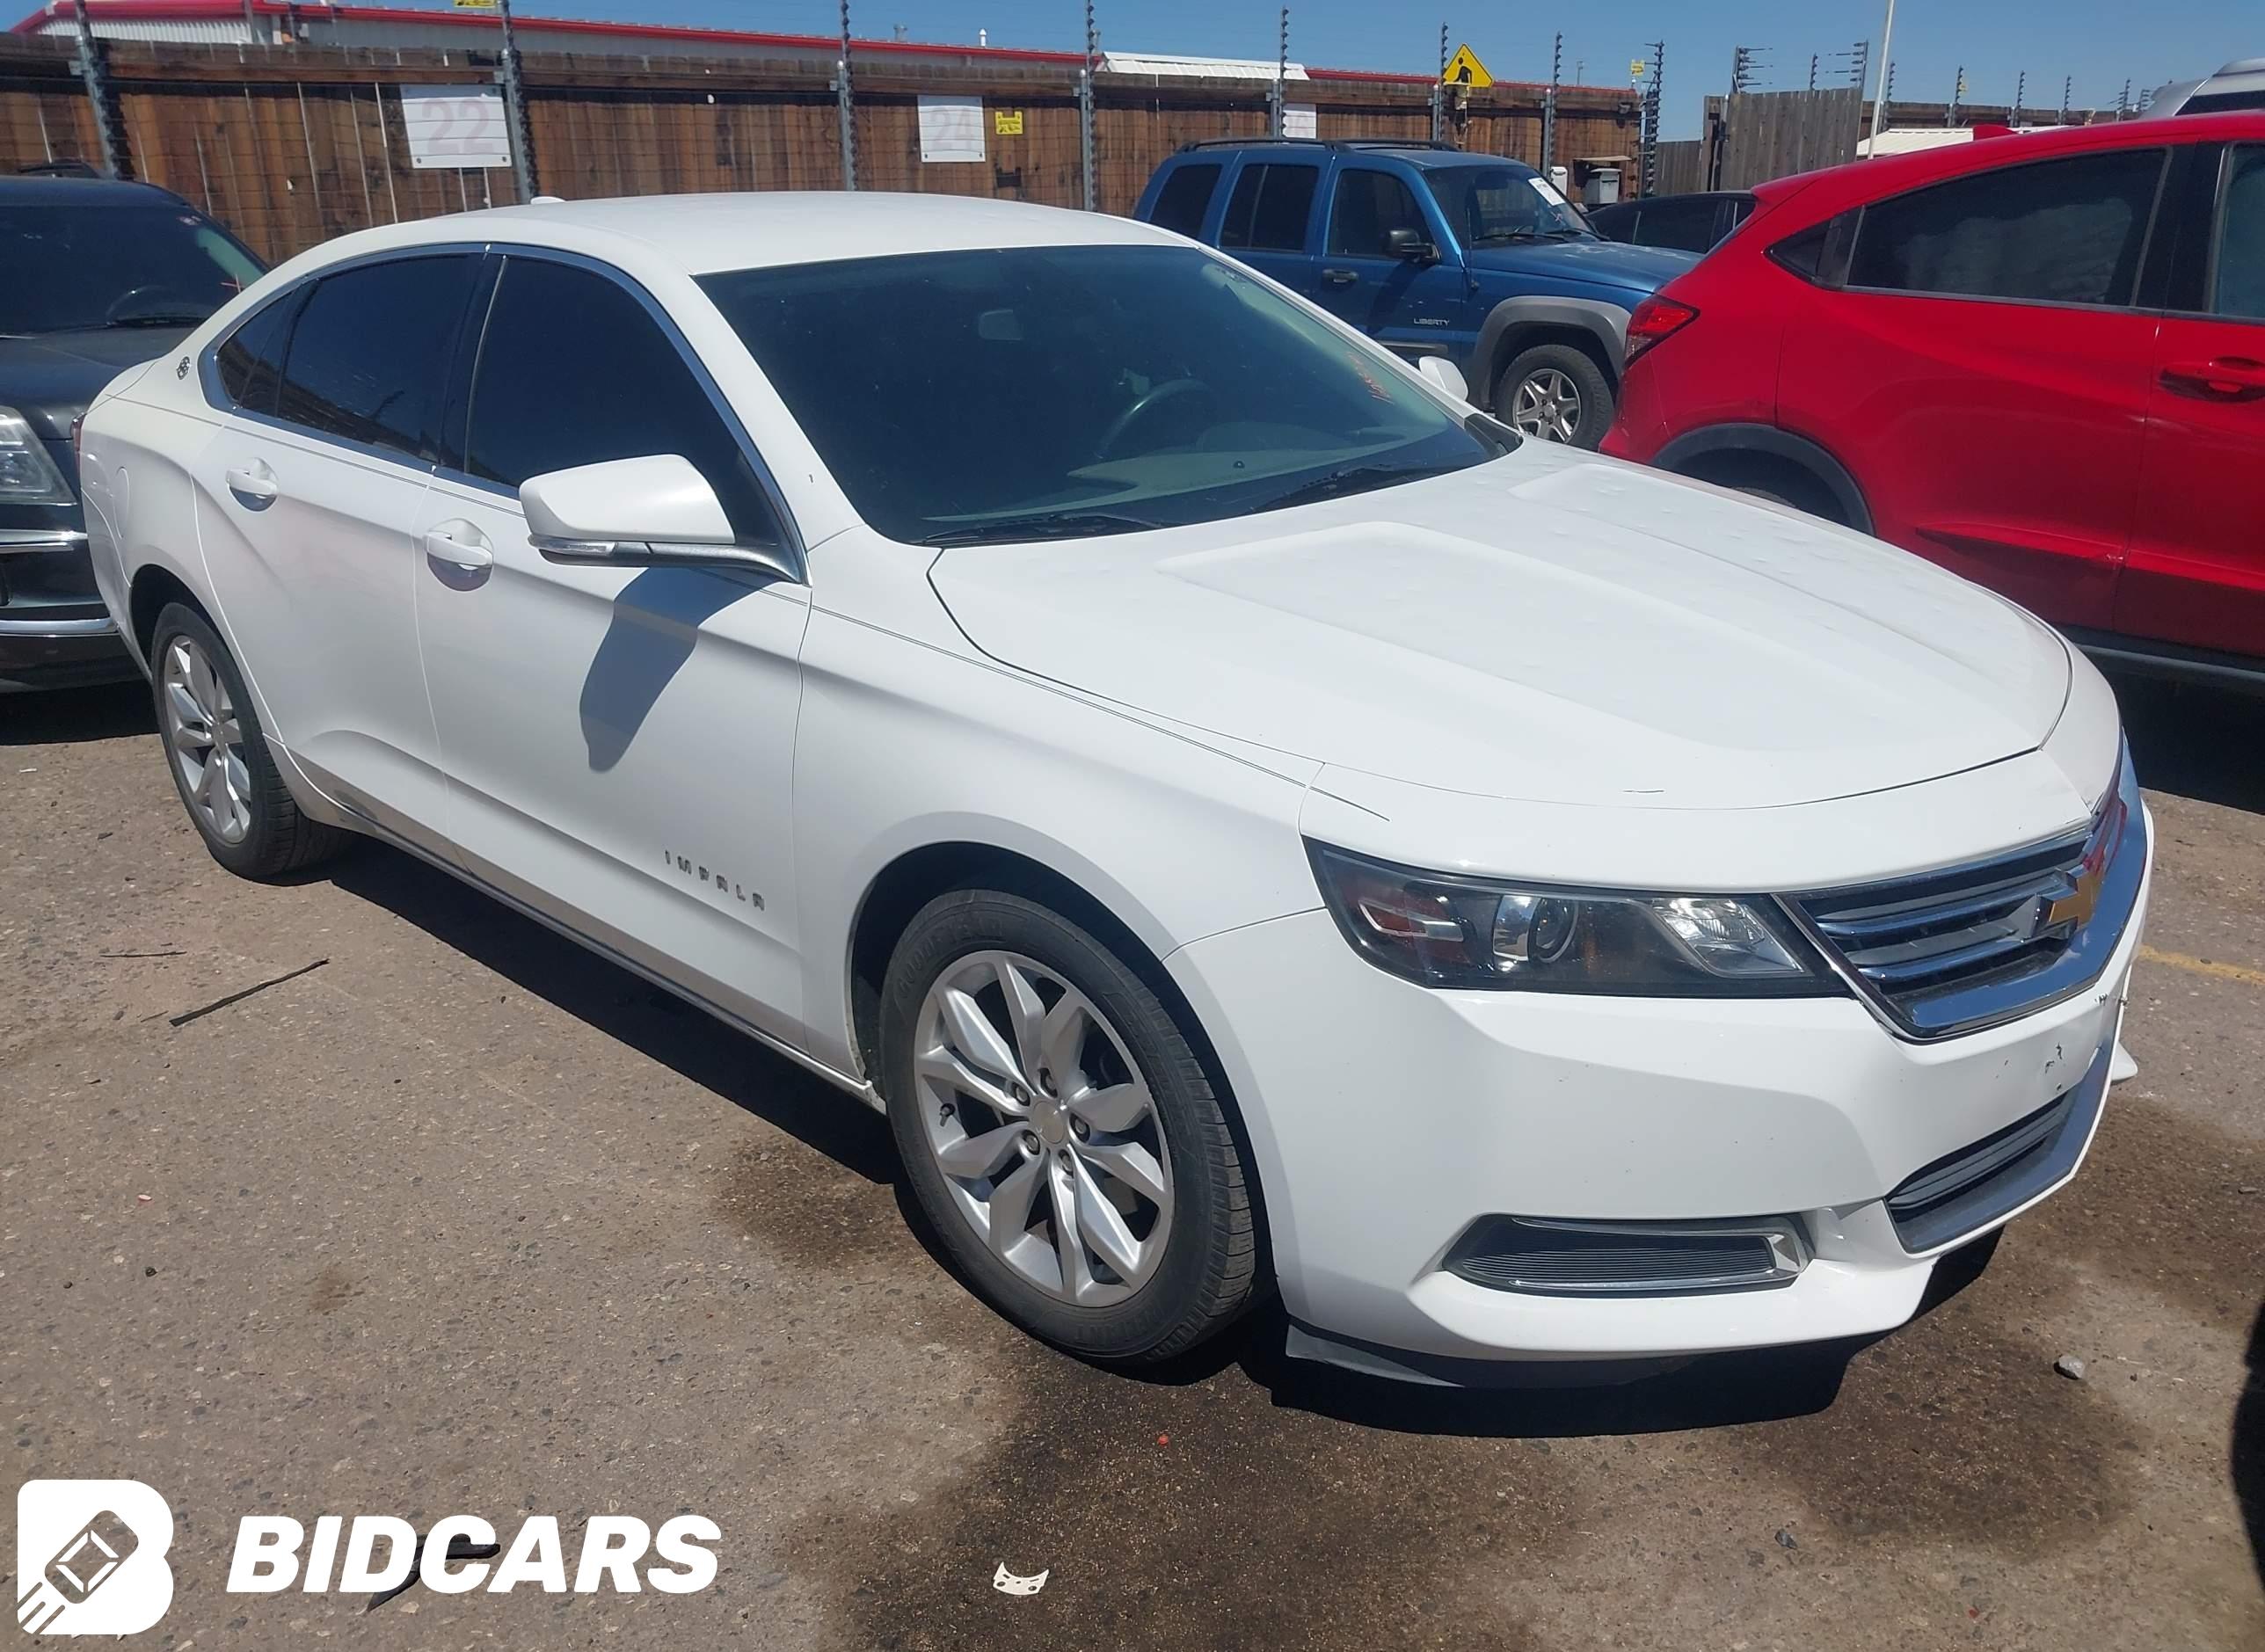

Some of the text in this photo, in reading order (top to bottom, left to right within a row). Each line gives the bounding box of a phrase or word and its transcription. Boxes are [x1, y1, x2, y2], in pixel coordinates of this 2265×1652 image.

[421, 98, 494, 156] 22
[1413, 317, 1450, 326] LIBERTY
[664, 848, 766, 912] IMPALA
